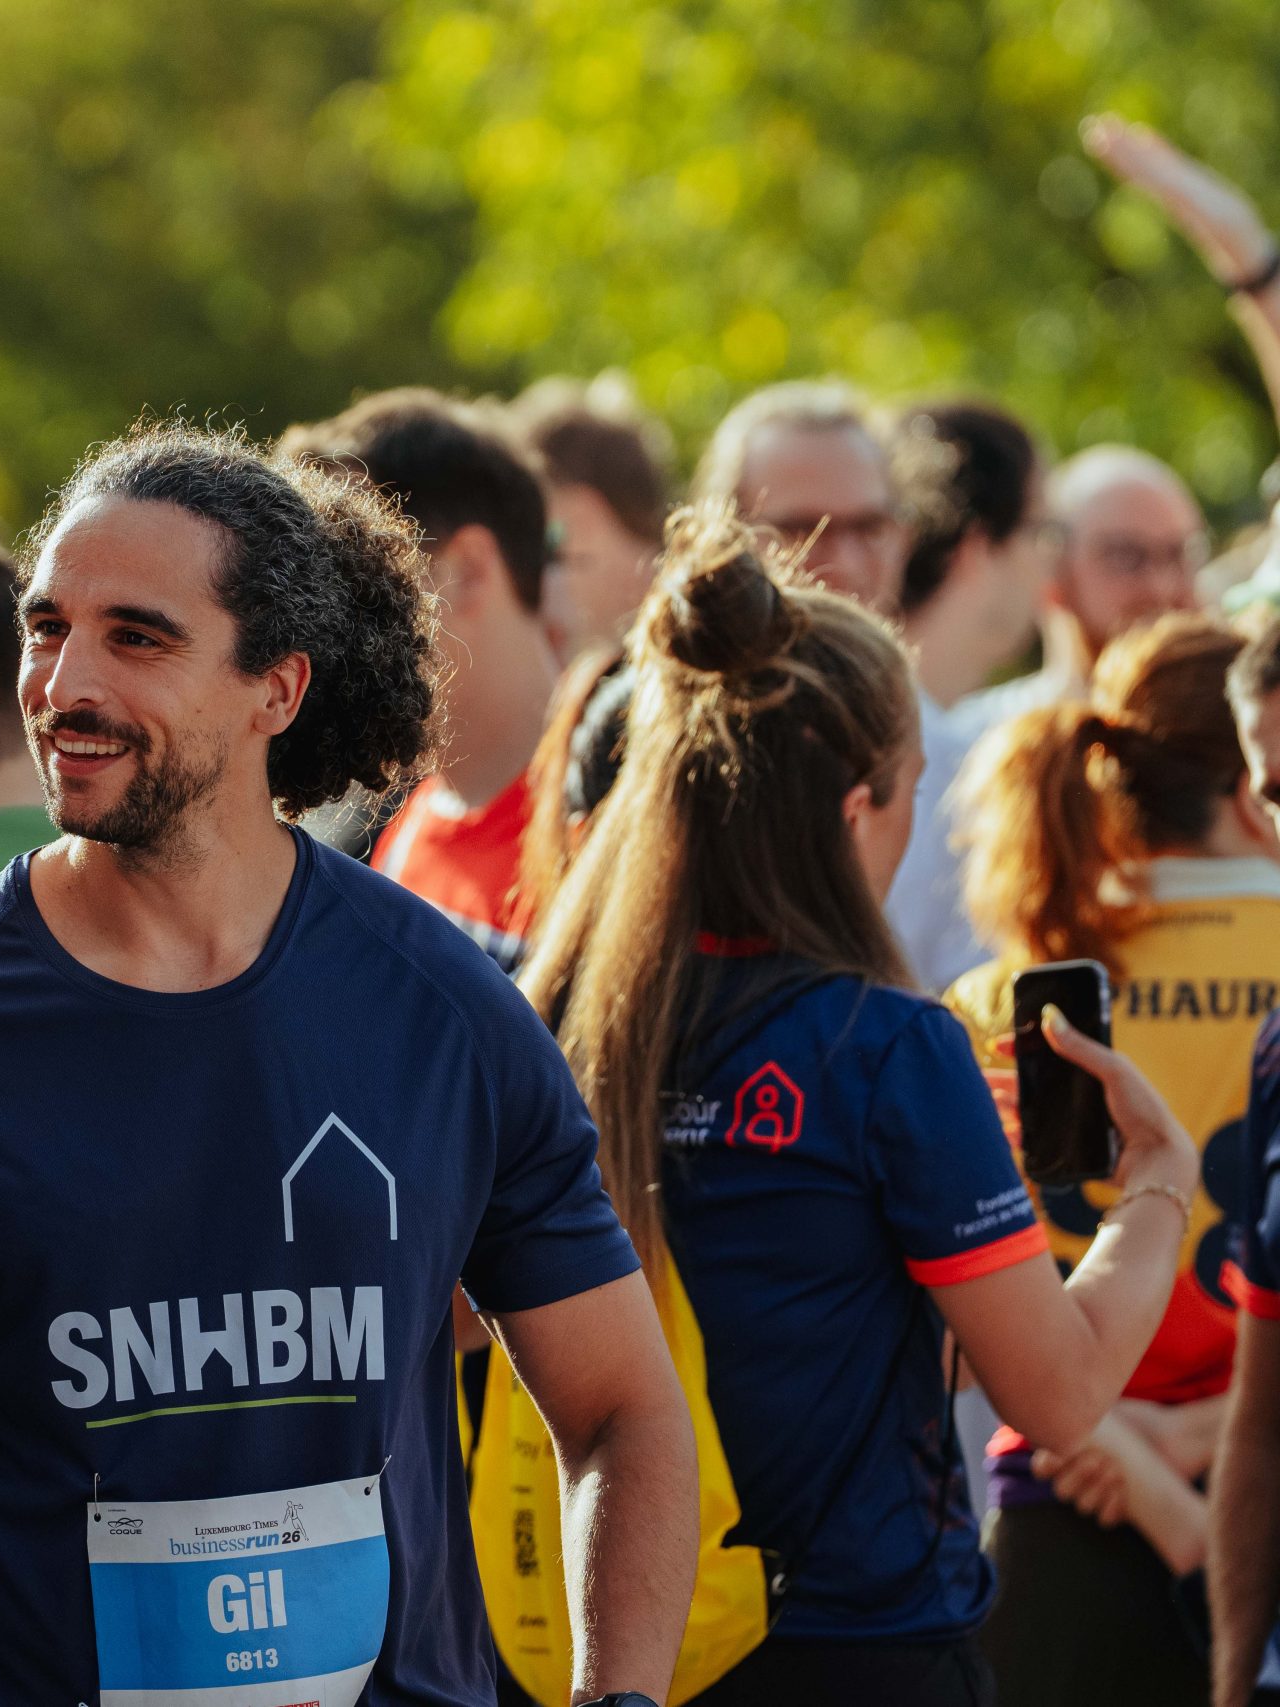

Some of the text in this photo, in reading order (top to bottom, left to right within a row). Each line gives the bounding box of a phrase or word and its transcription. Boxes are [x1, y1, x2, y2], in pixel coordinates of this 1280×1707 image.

[48, 1286, 386, 1409] SNHBM
[195, 1520, 279, 1536] LUXEMBOURG TIMES
[282, 1531, 301, 1544] 26
[208, 1569, 288, 1634] Gil
[226, 1648, 279, 1672] 6813
